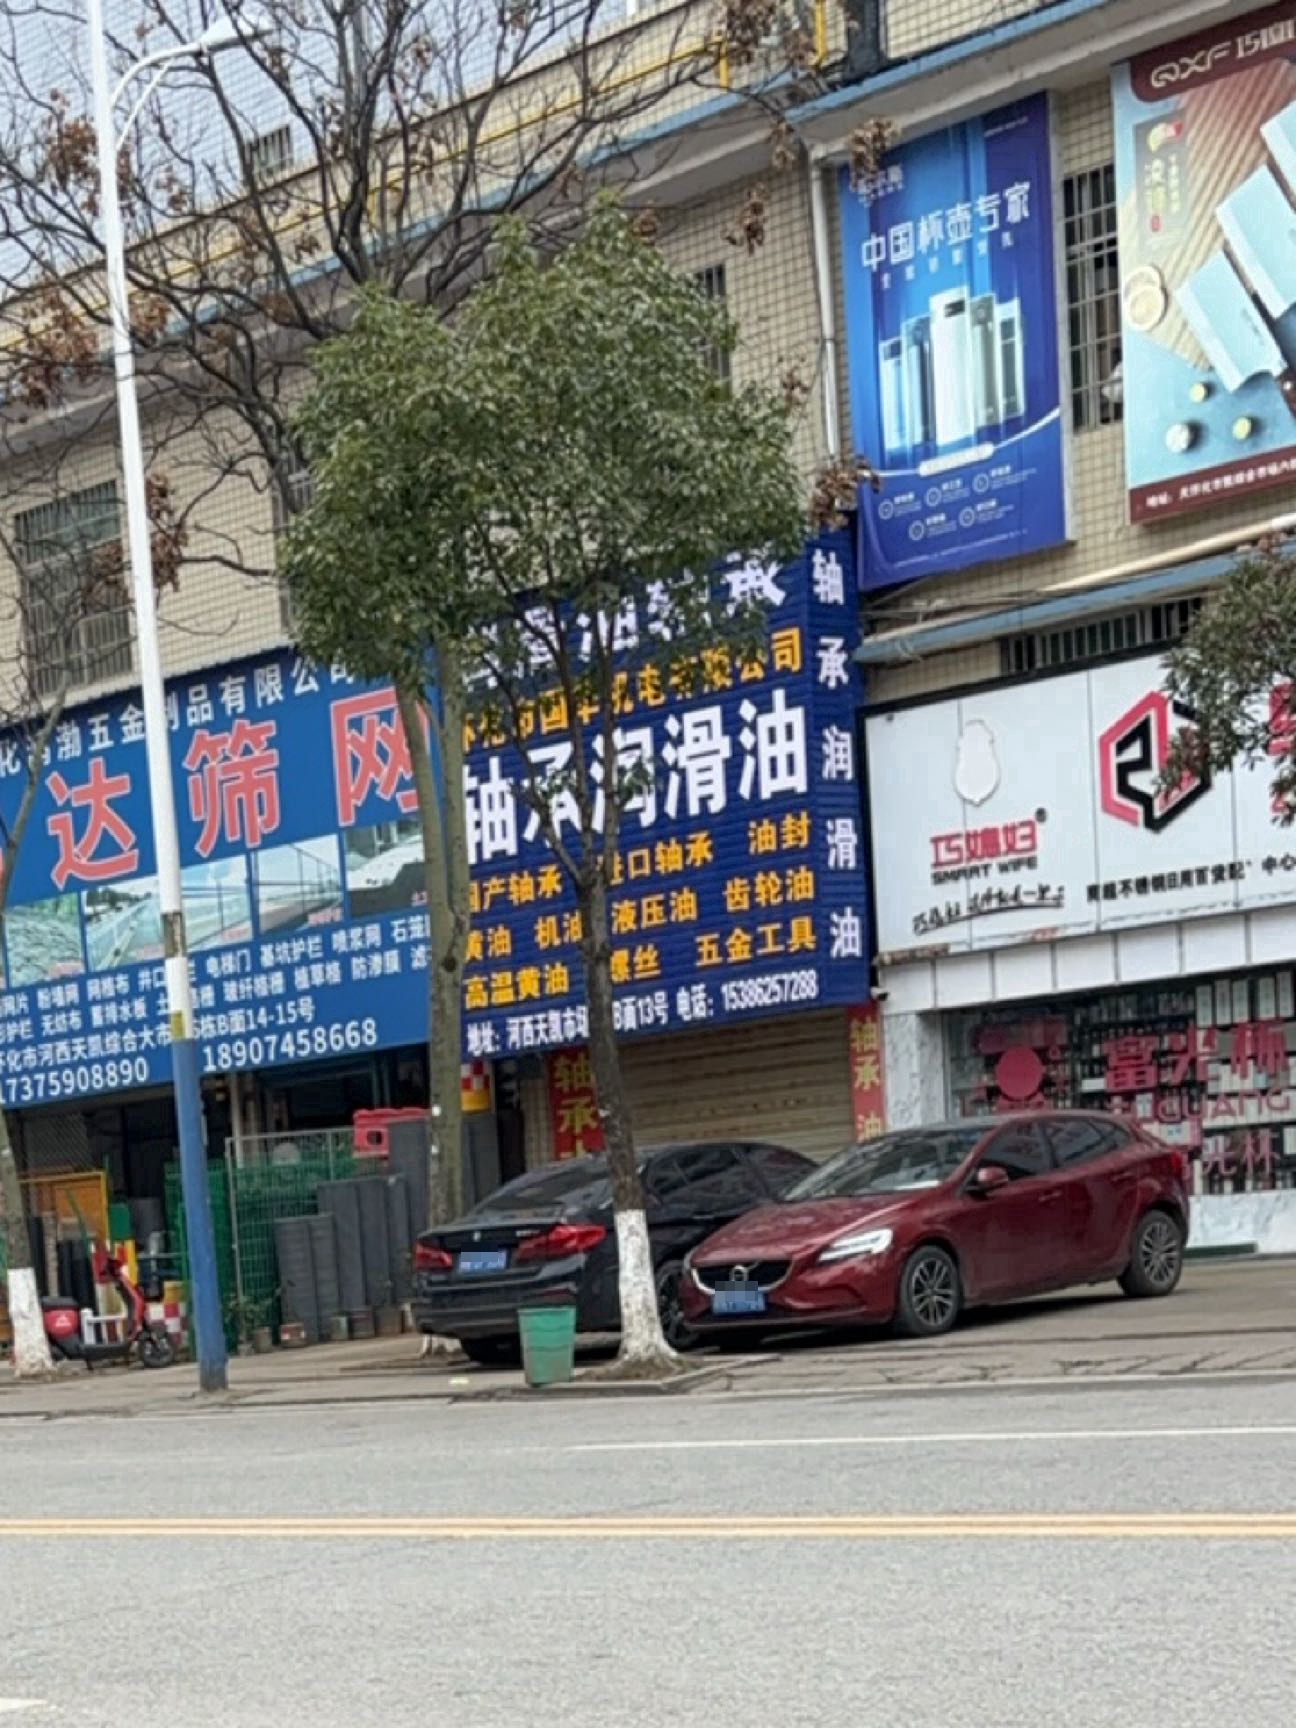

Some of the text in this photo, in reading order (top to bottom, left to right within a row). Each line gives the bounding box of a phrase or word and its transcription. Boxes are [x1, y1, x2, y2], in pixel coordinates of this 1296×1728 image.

[862, 181, 1030, 271] 中国杯壶专家
[464, 689, 808, 865] 轴承润滑油
[812, 548, 862, 959] 轴承润滑油
[749, 811, 811, 854] 油封
[466, 864, 815, 962] 黄油 机油 液压油 齿轮油
[931, 863, 991, 886] SMART
[391, 913, 431, 943] 石笼
[464, 962, 570, 1010] 高温黄油
[696, 916, 816, 967] 五金工具
[203, 1017, 377, 1073] 18907458668
[850, 1016, 880, 1090] 轴承
